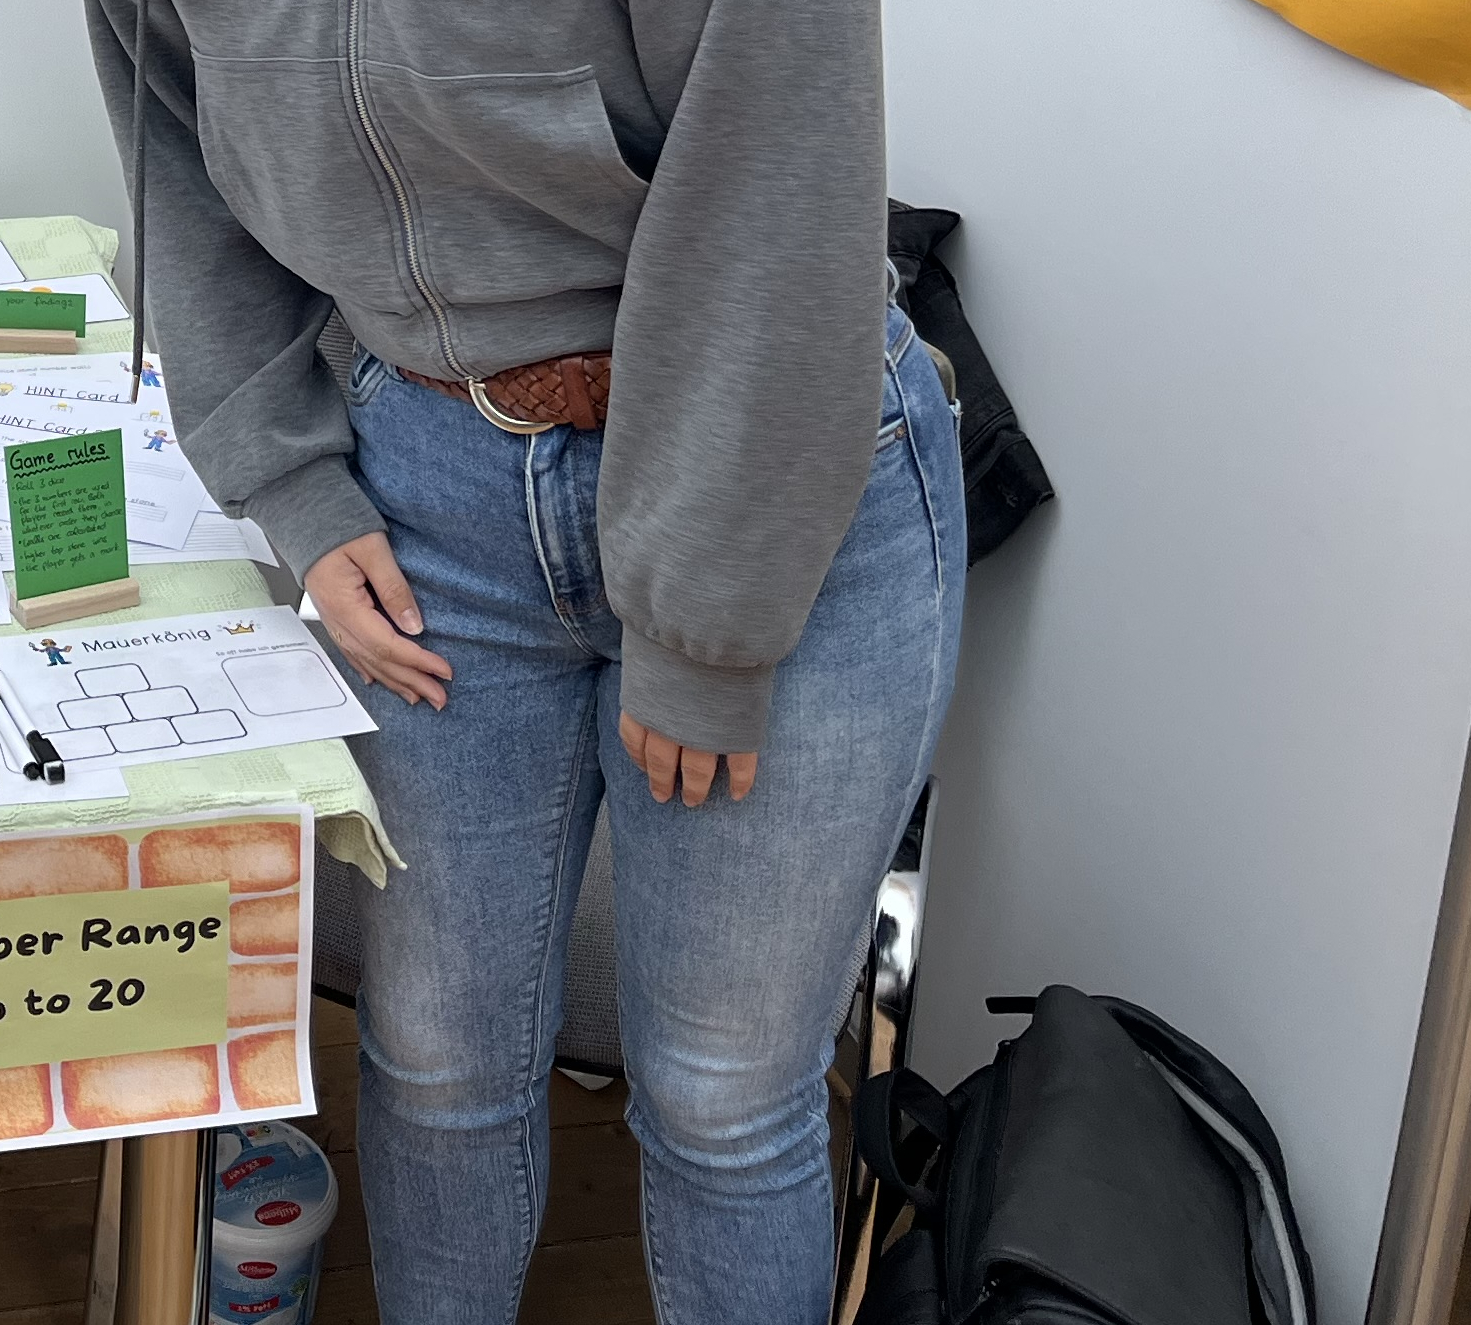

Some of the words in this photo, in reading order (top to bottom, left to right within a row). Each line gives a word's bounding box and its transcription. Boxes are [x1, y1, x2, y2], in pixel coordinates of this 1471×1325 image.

[26, 386, 67, 397] HINT
[77, 390, 119, 402] Card
[44, 422, 88, 435] Card
[10, 450, 55, 470] Game
[68, 441, 105, 461] rules
[81, 628, 211, 653] Mauerkönig
[82, 917, 221, 953] Range
[24, 989, 70, 1015] to
[88, 979, 145, 1011] 20
